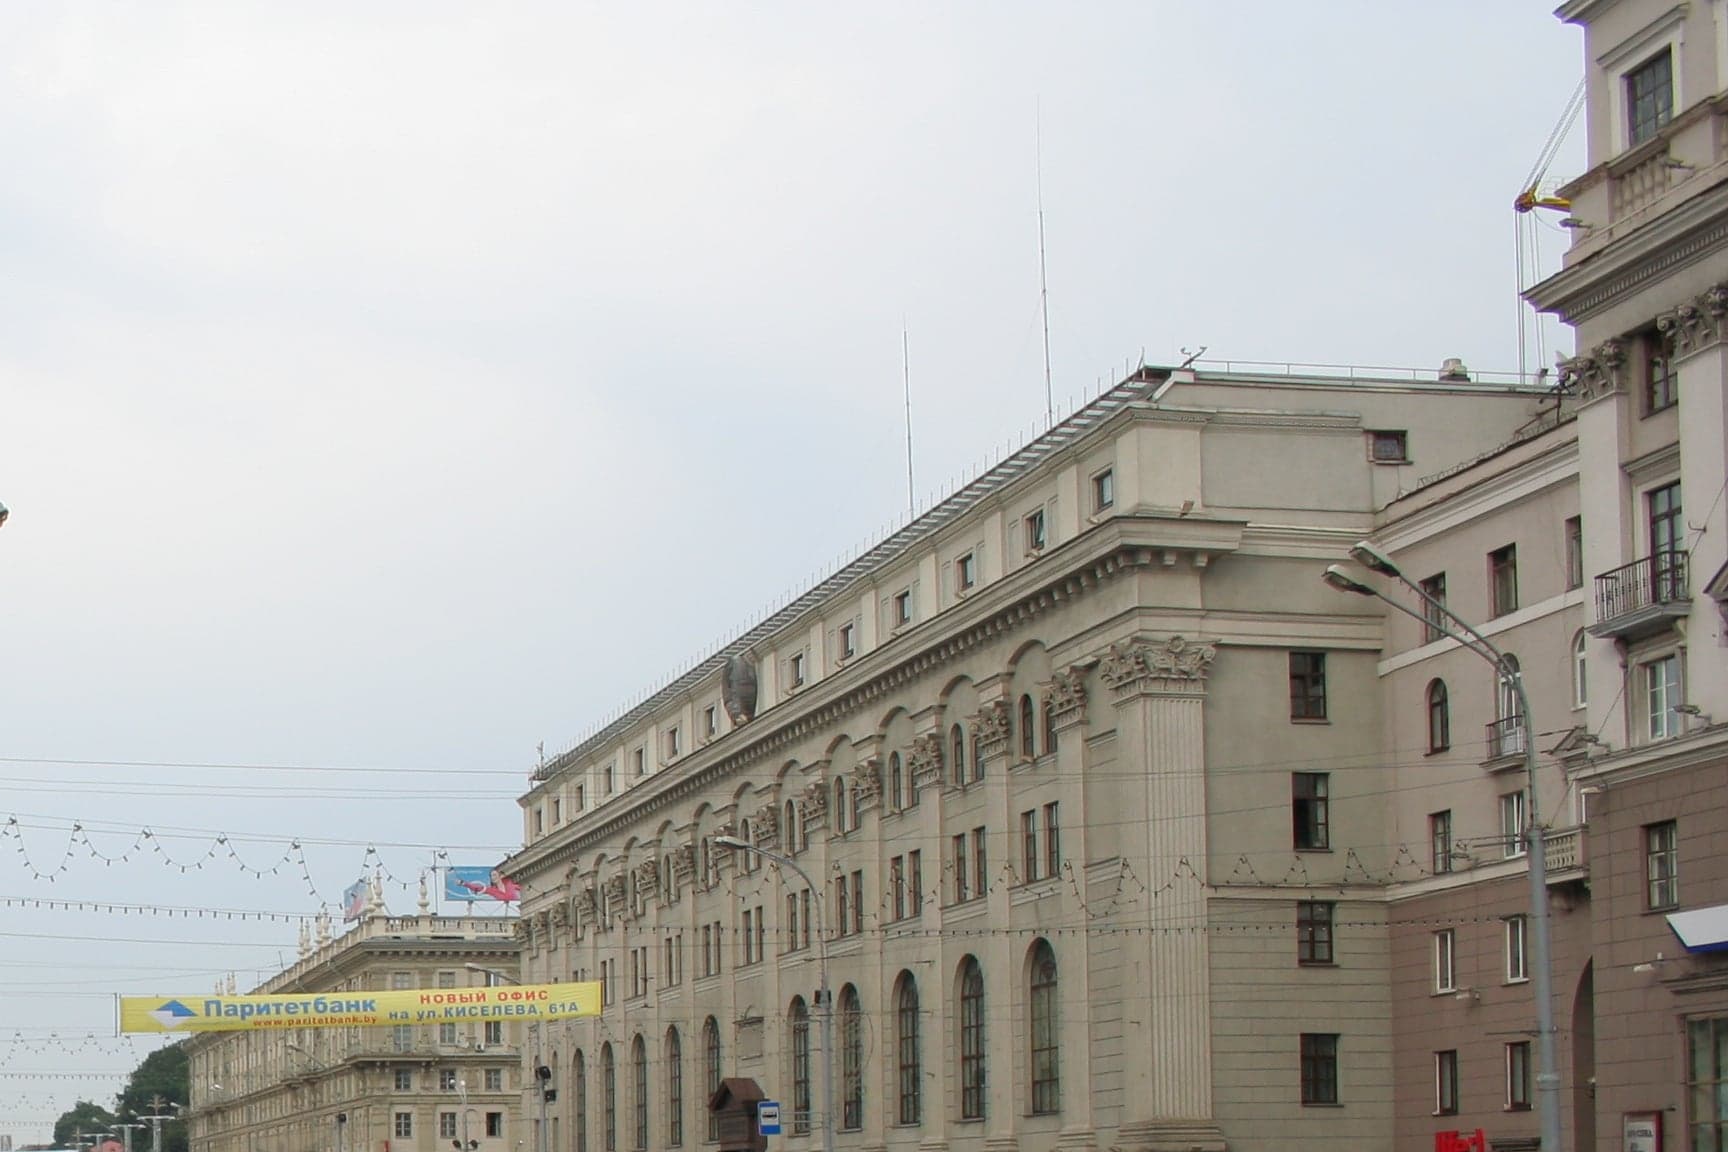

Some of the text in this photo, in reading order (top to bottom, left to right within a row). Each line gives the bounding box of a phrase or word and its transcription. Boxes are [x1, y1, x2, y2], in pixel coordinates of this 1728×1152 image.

[420, 990, 548, 1004] НОВЫЙ ОФИС
[204, 997, 376, 1020] Паритетбанк
[388, 1011, 409, 1020] на
[549, 1002, 578, 1013] 61А
[254, 1015, 377, 1026] www.paritetbank.by
